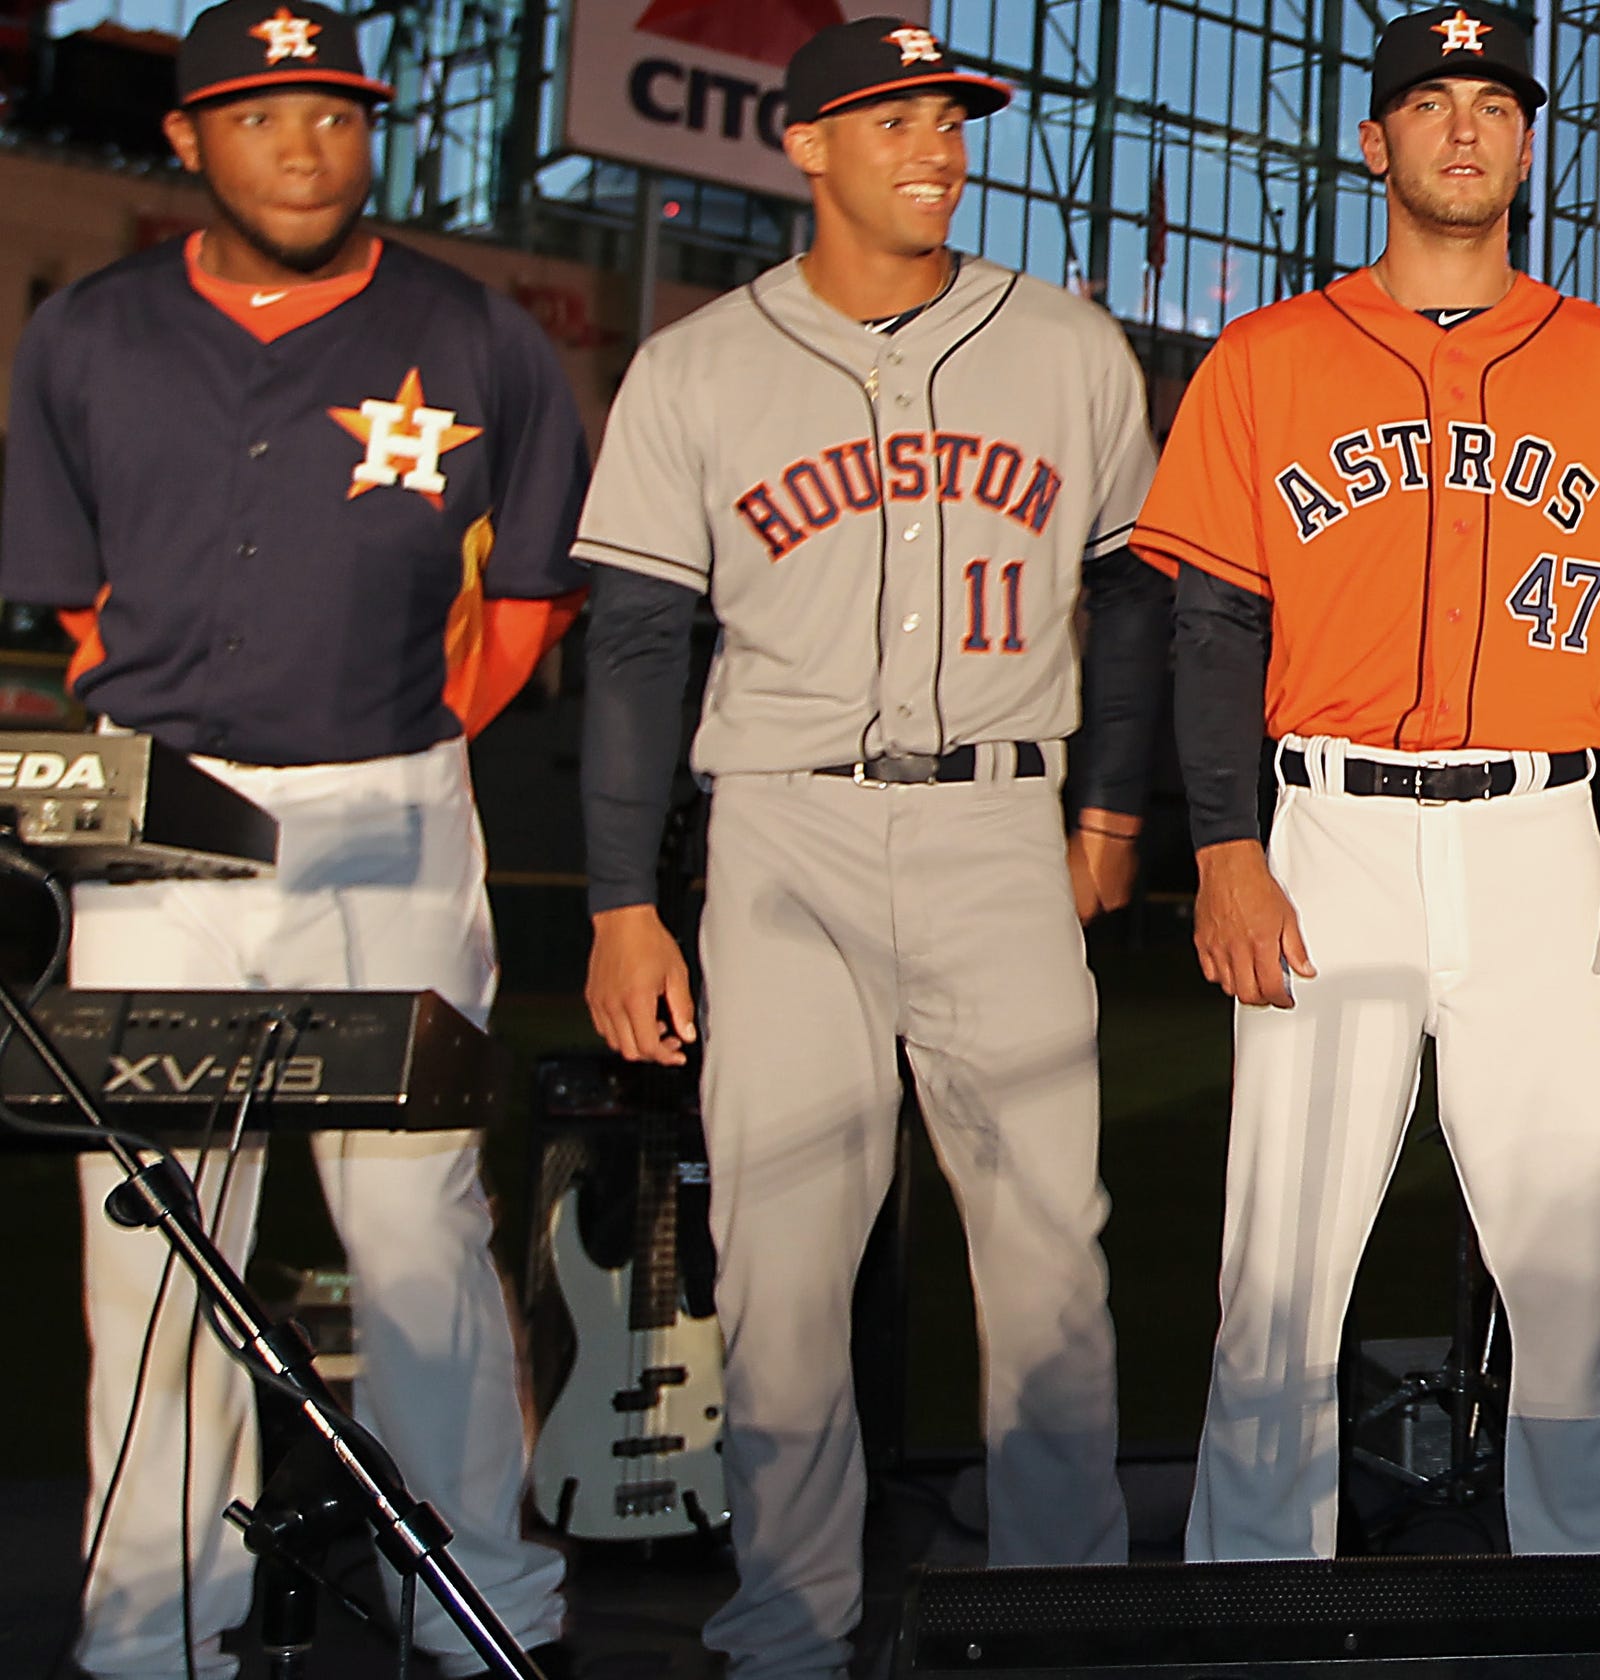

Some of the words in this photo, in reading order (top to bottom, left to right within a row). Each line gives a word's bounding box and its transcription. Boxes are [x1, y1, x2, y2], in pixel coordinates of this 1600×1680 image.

[260, 18, 317, 58] H
[890, 28, 942, 61] H
[1441, 19, 1485, 50] H
[354, 398, 457, 494] H
[1274, 419, 1600, 544] ASTROS
[733, 431, 1063, 563] HOUSTON
[961, 557, 1027, 654] 11
